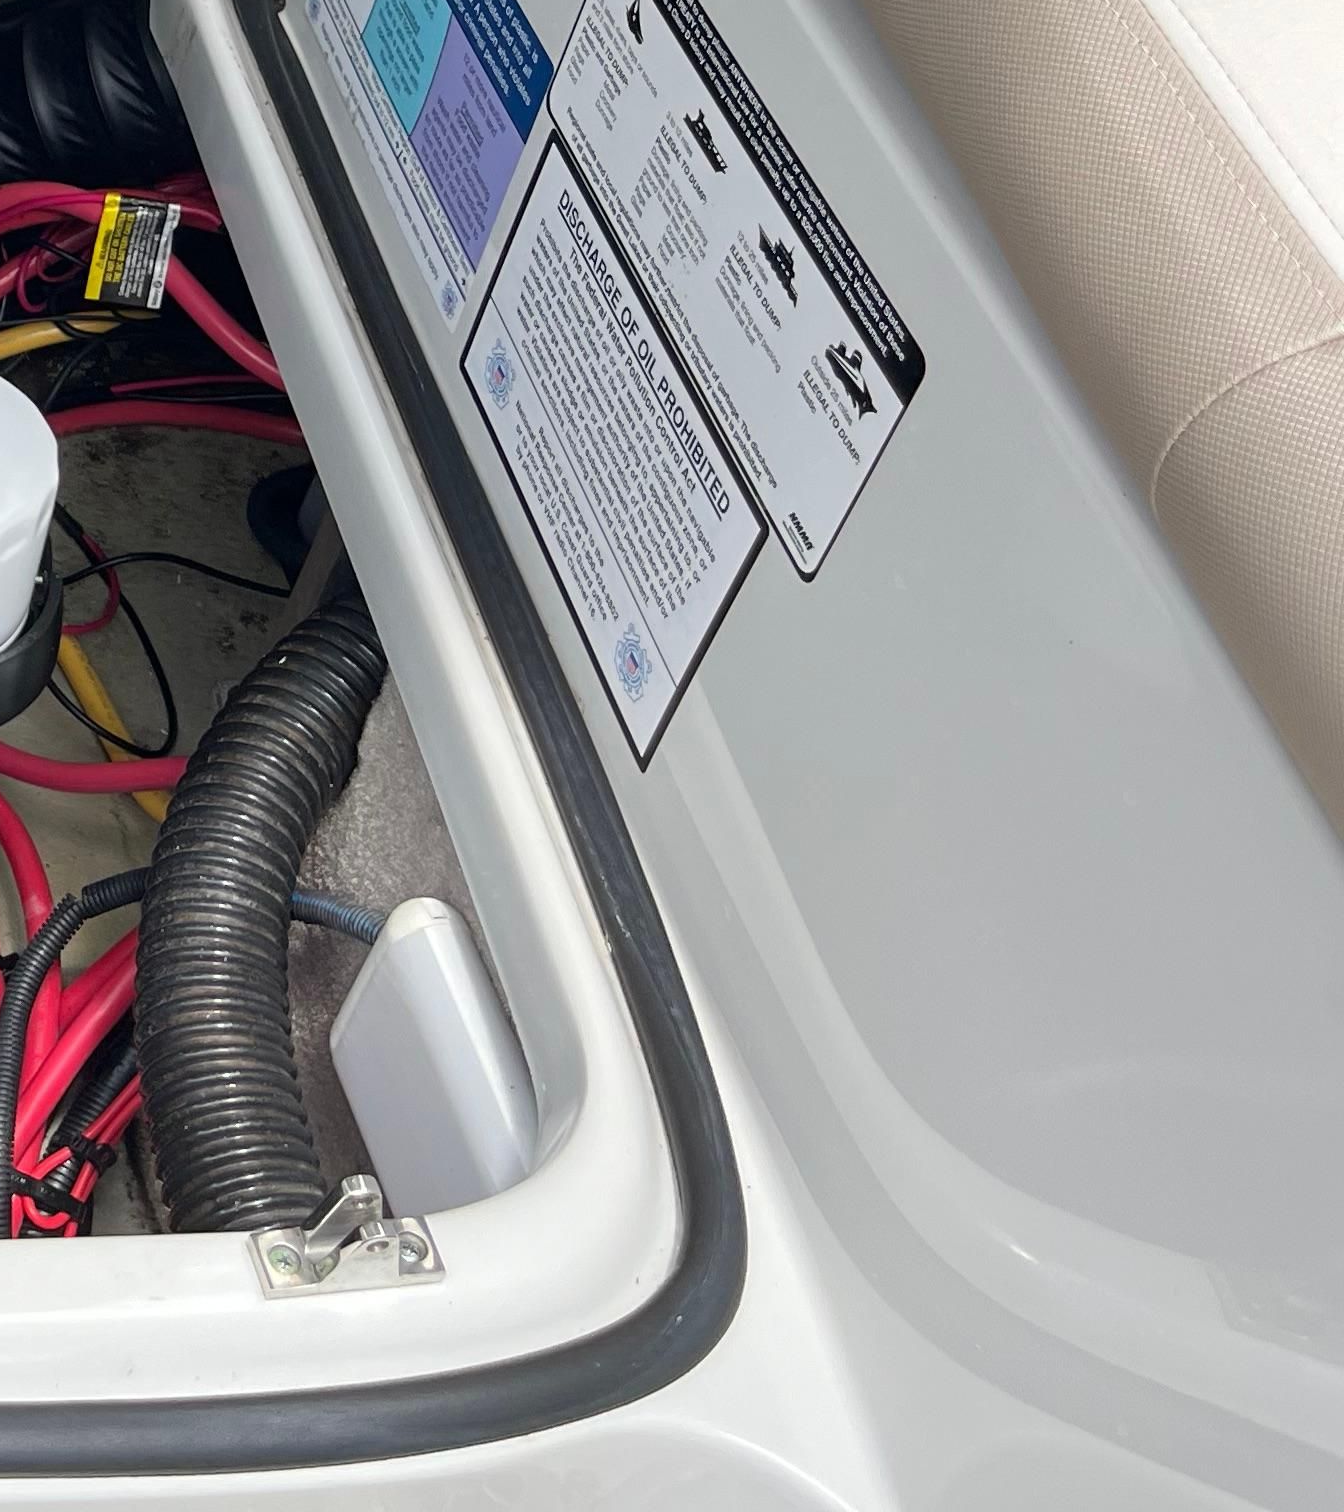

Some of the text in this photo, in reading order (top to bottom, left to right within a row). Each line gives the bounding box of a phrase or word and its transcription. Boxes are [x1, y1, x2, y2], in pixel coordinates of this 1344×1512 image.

[585, 13, 605, 50] ILLEGAL
[604, 46, 613, 63] TO
[659, 123, 682, 163] ILLEGAL
[680, 158, 690, 177] TO
[729, 242, 753, 284] ILLEGAL
[752, 281, 762, 300] TO
[799, 214, 824, 254] $25,000
[821, 249, 835, 272] fine
[832, 267, 847, 291] and
[559, 187, 731, 518] DISCHARGE OF OIL PROHIBITED
[568, 245, 697, 496] The Federal Water Pollution Control Act
[536, 231, 553, 268] waters
[552, 263, 559, 279] of
[557, 274, 568, 296] the
[566, 292, 584, 329] United
[600, 360, 609, 378] or
[607, 373, 618, 396] the
[616, 392, 636, 432] waters
[634, 428, 643, 445] of
[641, 441, 653, 464] the
[698, 555, 708, 574] or
[797, 379, 817, 415] Plastic
[803, 367, 830, 415] ILLEGAL
[827, 410, 839, 431] TO
[810, 353, 853, 427] Outside 25 miles
[515, 443, 523, 461] by
[521, 457, 538, 494] phone
[536, 490, 544, 507] or
[543, 504, 554, 530] VHF
[553, 526, 568, 559] radio
[566, 555, 588, 604] Channel
